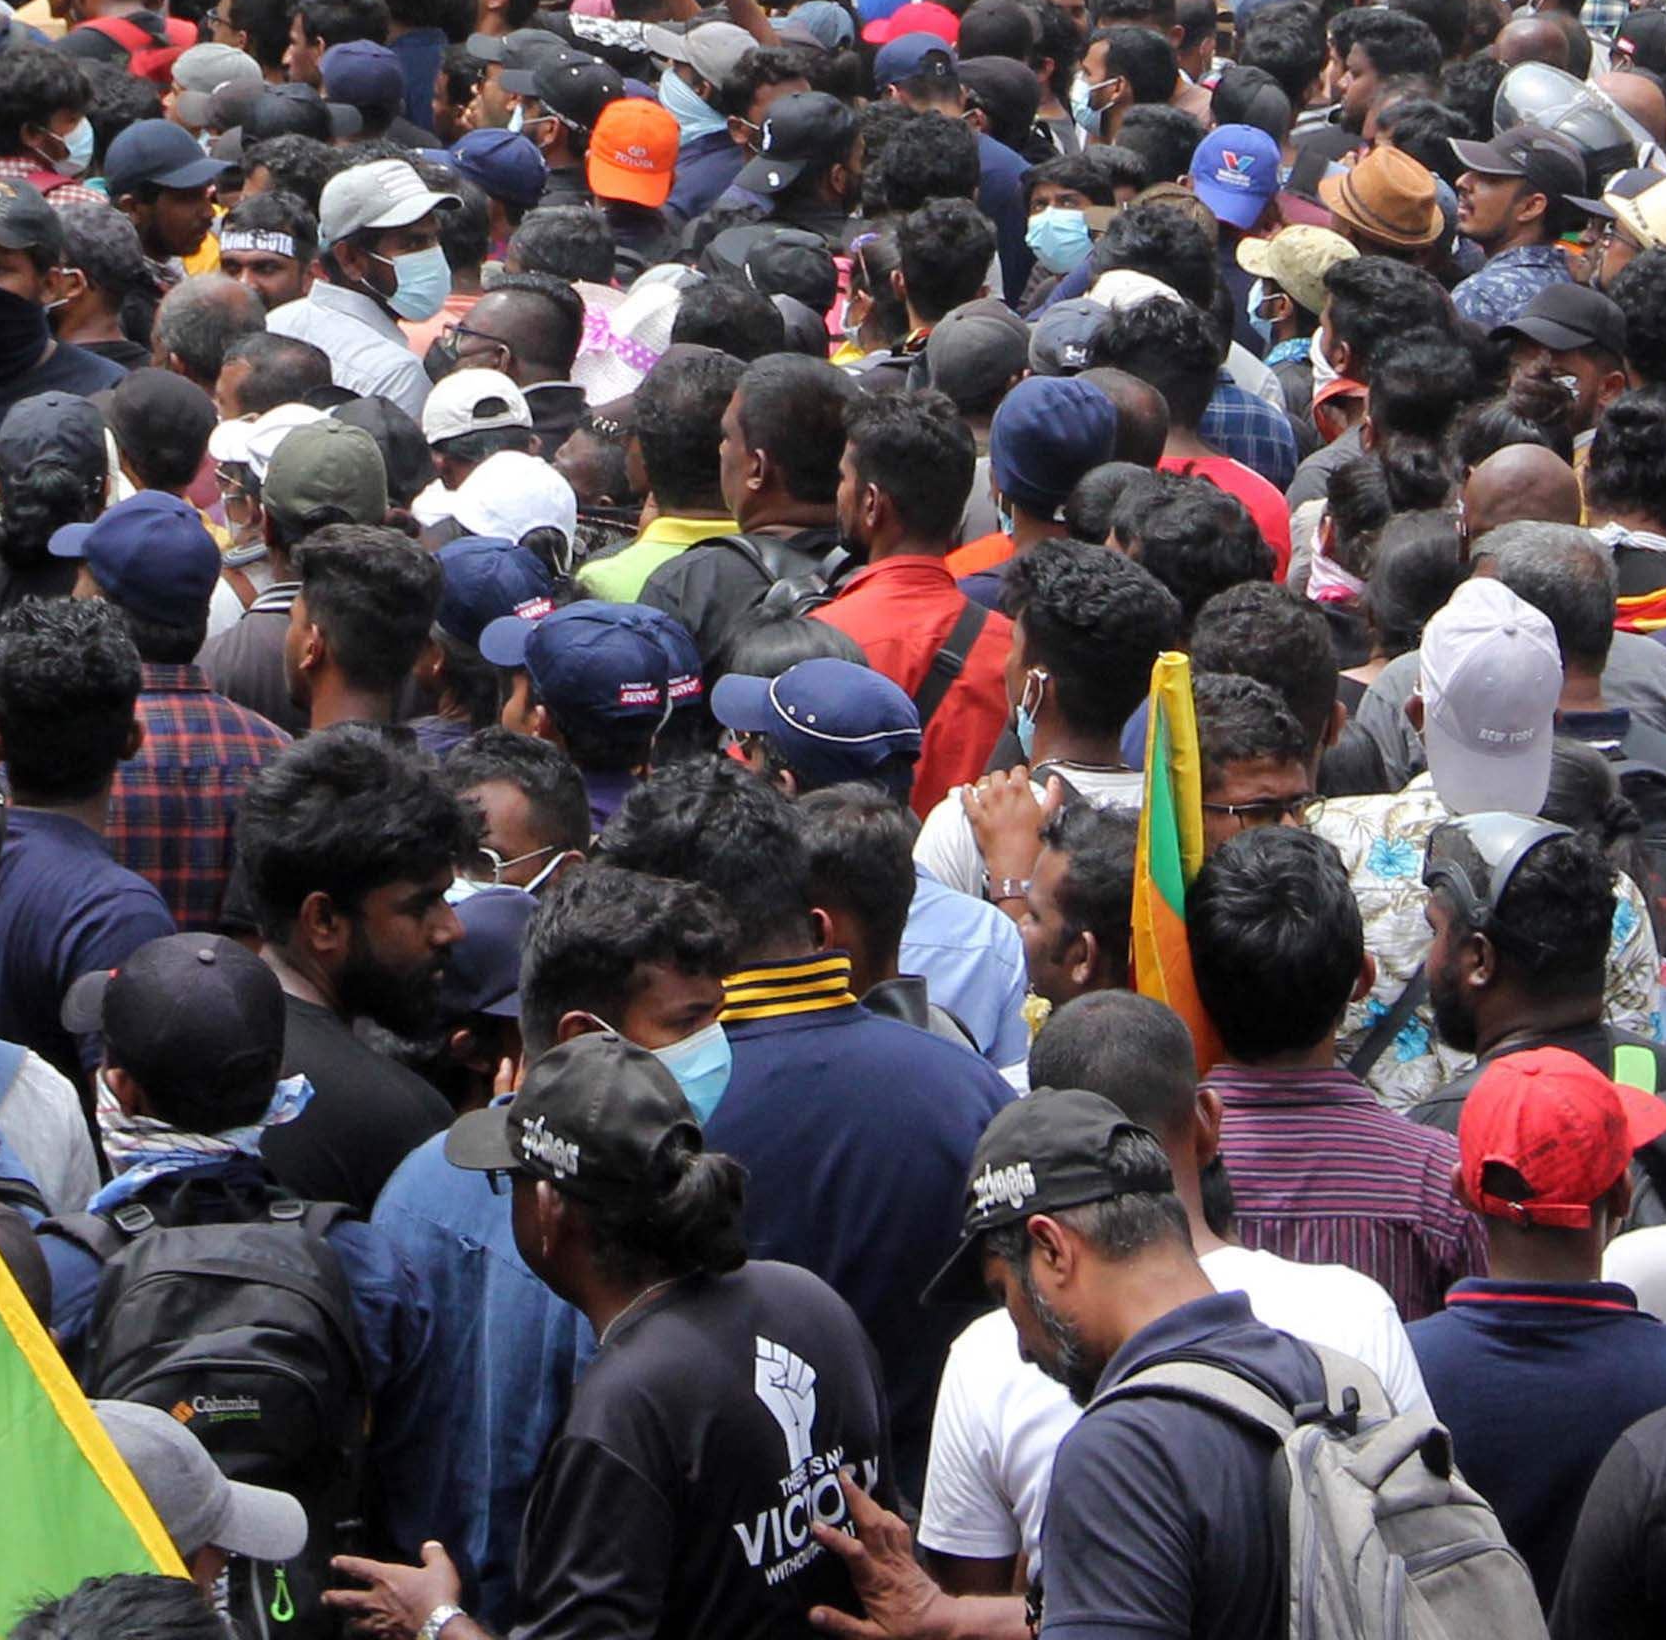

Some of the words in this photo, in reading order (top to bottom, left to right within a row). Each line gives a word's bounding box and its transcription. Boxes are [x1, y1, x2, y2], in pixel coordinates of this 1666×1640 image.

[615, 151, 653, 168] TOYOTA
[620, 689, 660, 704] SERVO
[1478, 727, 1505, 742] NEW
[1507, 727, 1534, 744] YORK
[193, 1395, 260, 1413] Columbia
